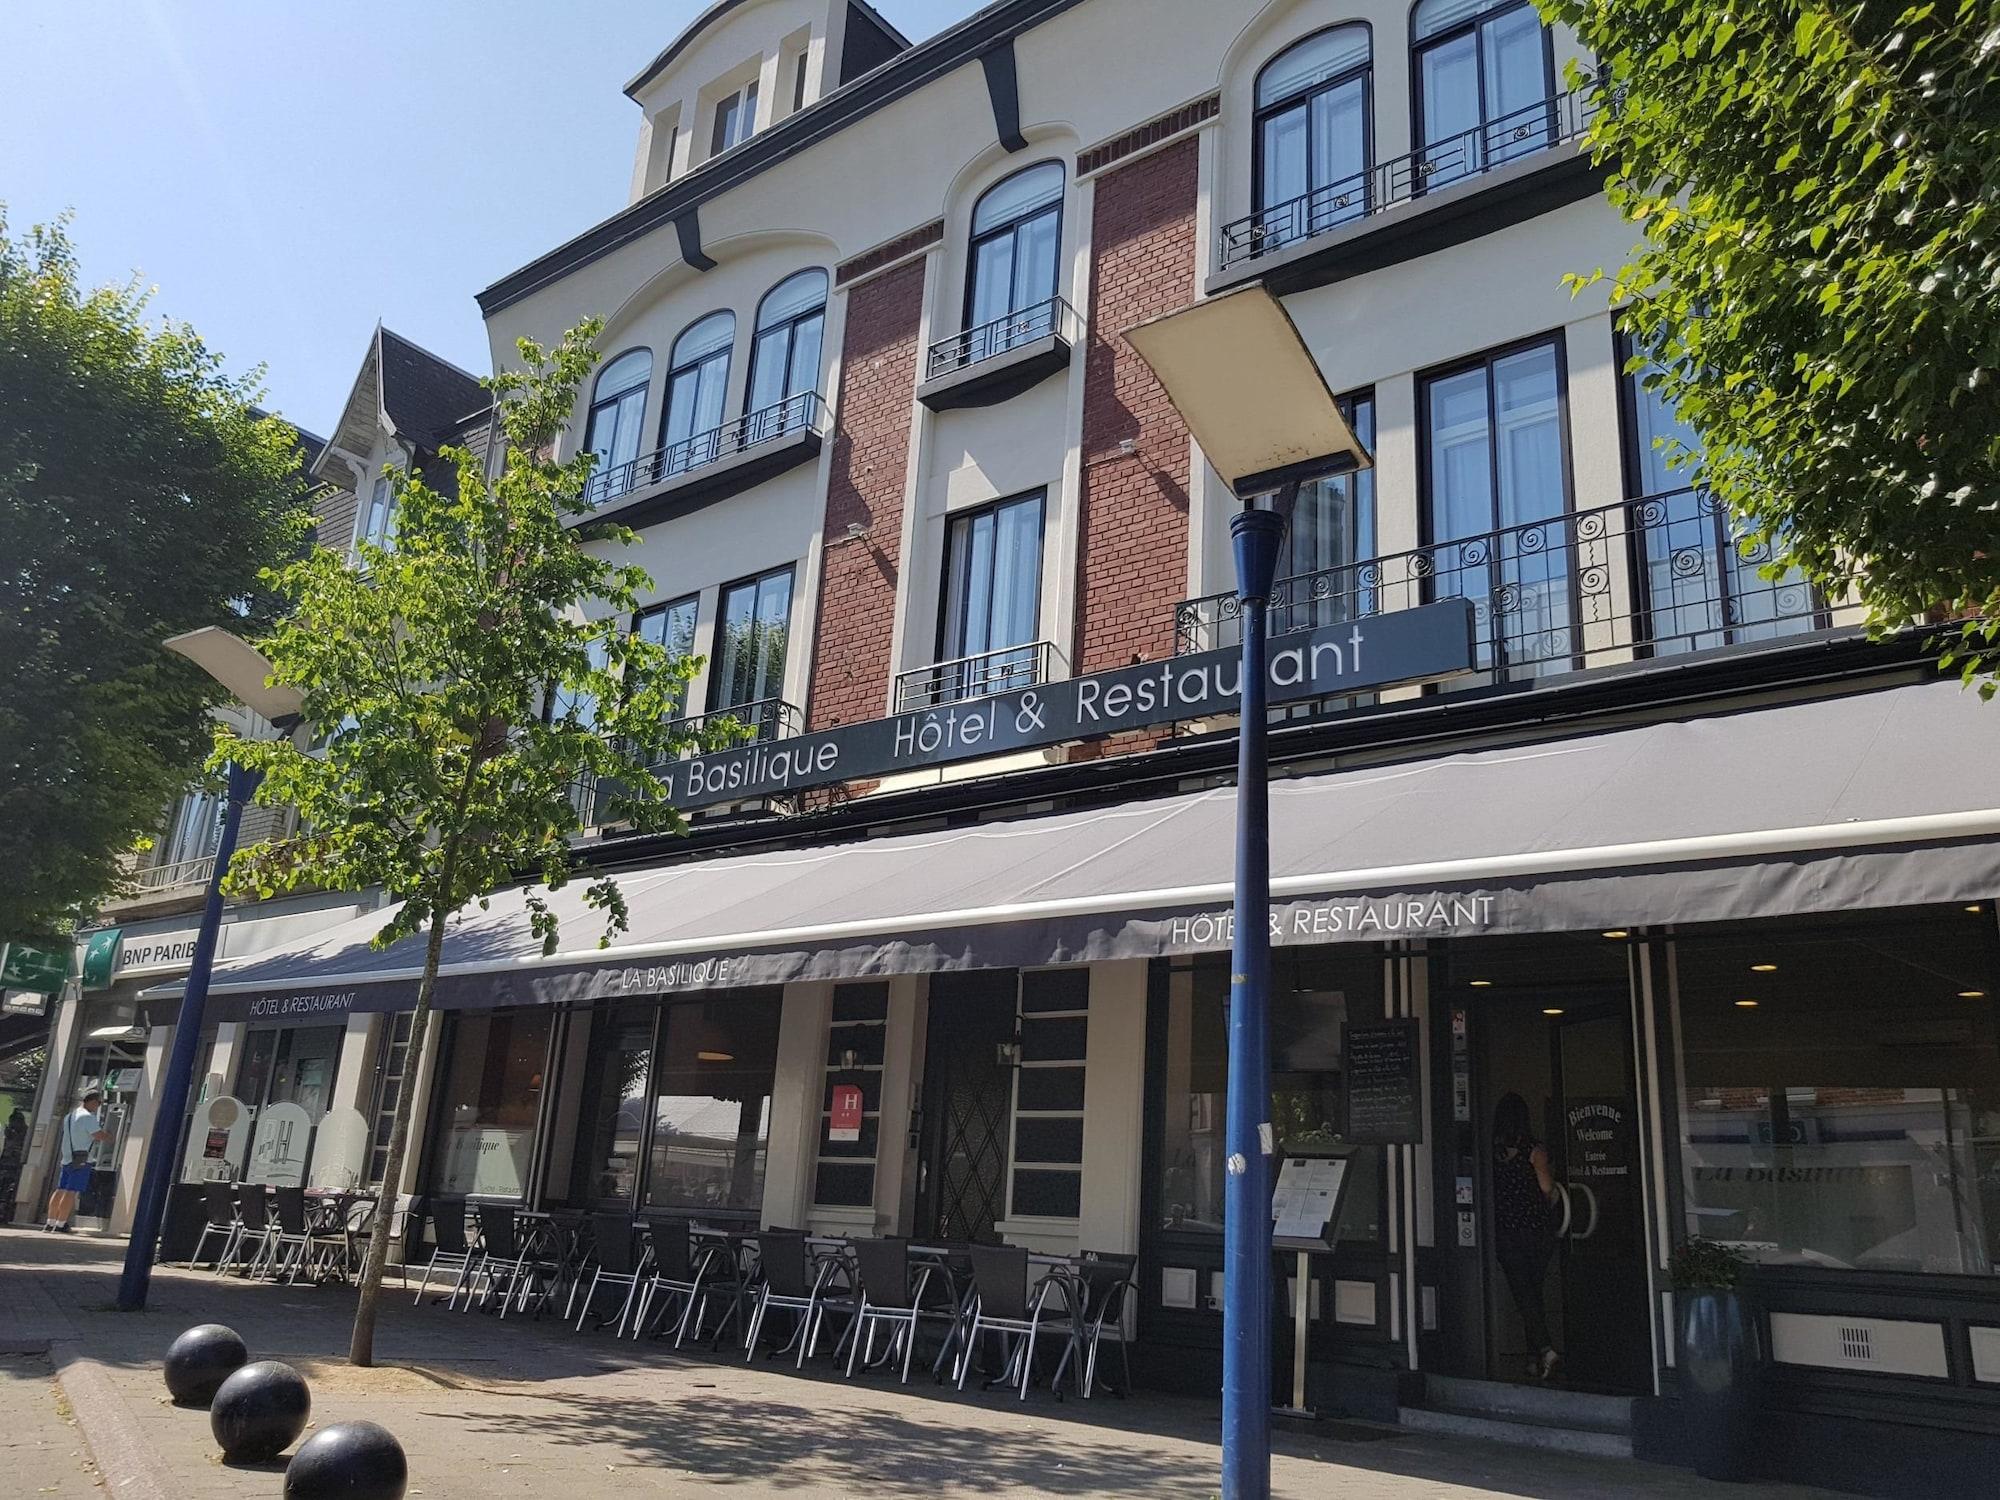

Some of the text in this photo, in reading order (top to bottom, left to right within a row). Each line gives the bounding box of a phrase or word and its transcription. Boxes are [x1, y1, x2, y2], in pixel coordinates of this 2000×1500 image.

[893, 624, 1365, 758] Hôtel & Restauant
[687, 741, 840, 798] Basilique
[1172, 912, 1235, 945] HÔTE
[1293, 896, 1495, 935] RESTAURANT
[122, 941, 196, 965] BNP PARIB
[622, 959, 729, 989] LA BASILIQUE
[249, 992, 356, 1016] HÔTEL & RESTAURANT
[845, 1093, 858, 1110] H
[1576, 1128, 1614, 1142] Welcome
